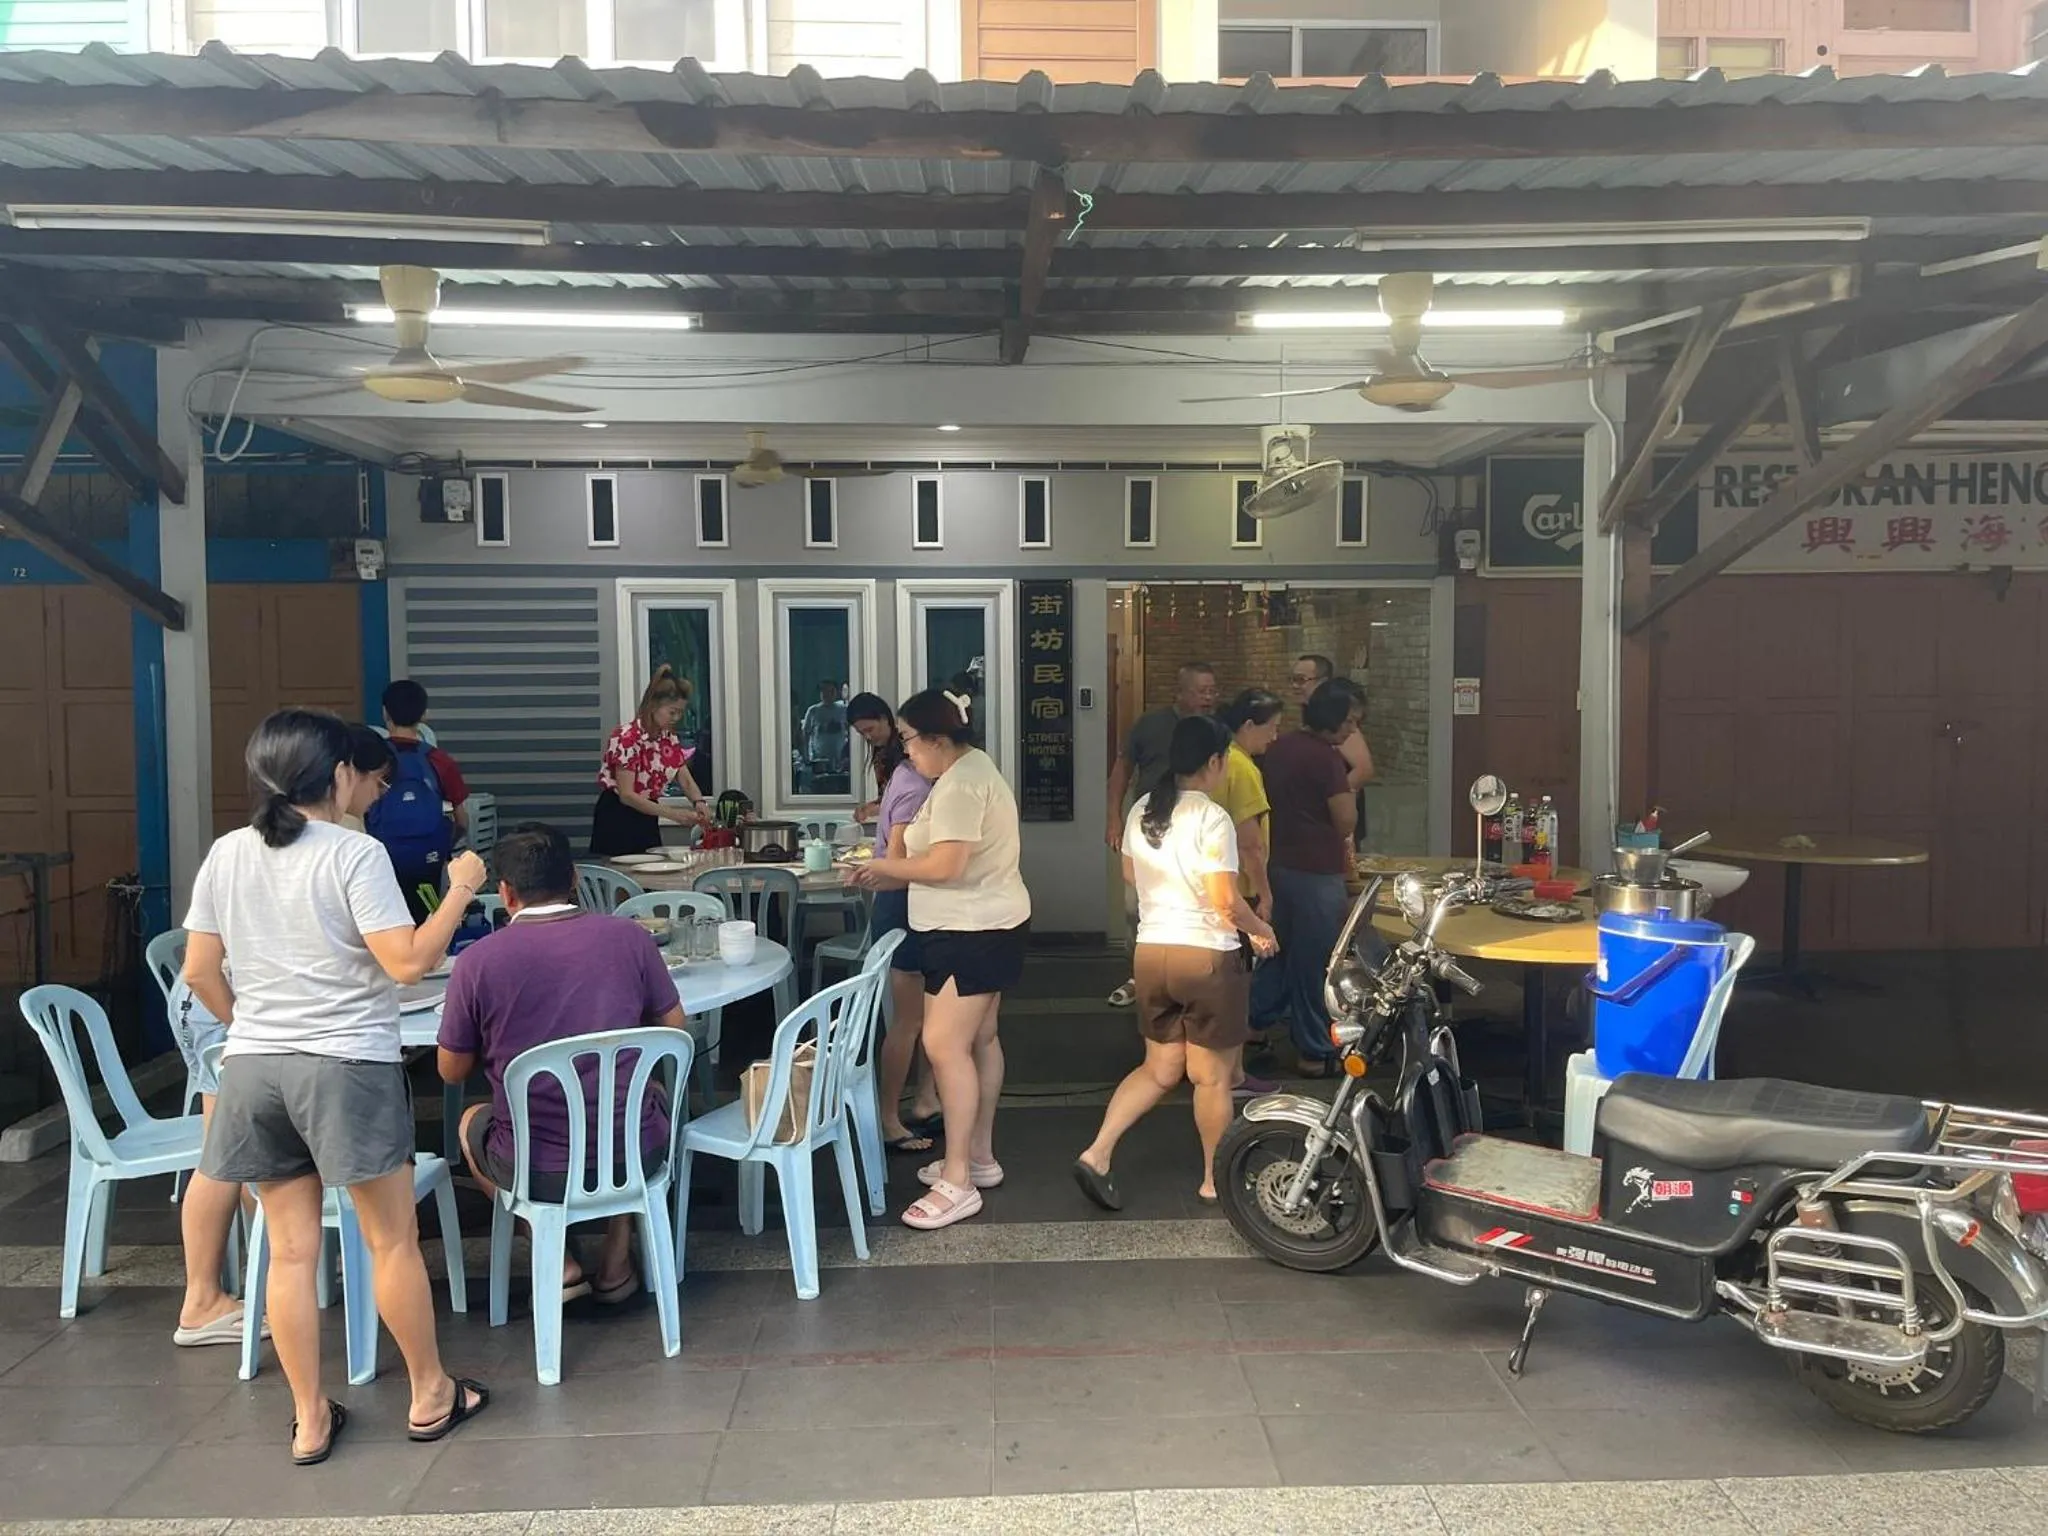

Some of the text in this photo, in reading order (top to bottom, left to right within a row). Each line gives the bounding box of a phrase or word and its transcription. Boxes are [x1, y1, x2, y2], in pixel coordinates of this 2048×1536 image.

[1029, 594, 1065, 719] 街坊民宿
[1027, 733, 1066, 743] STREET
